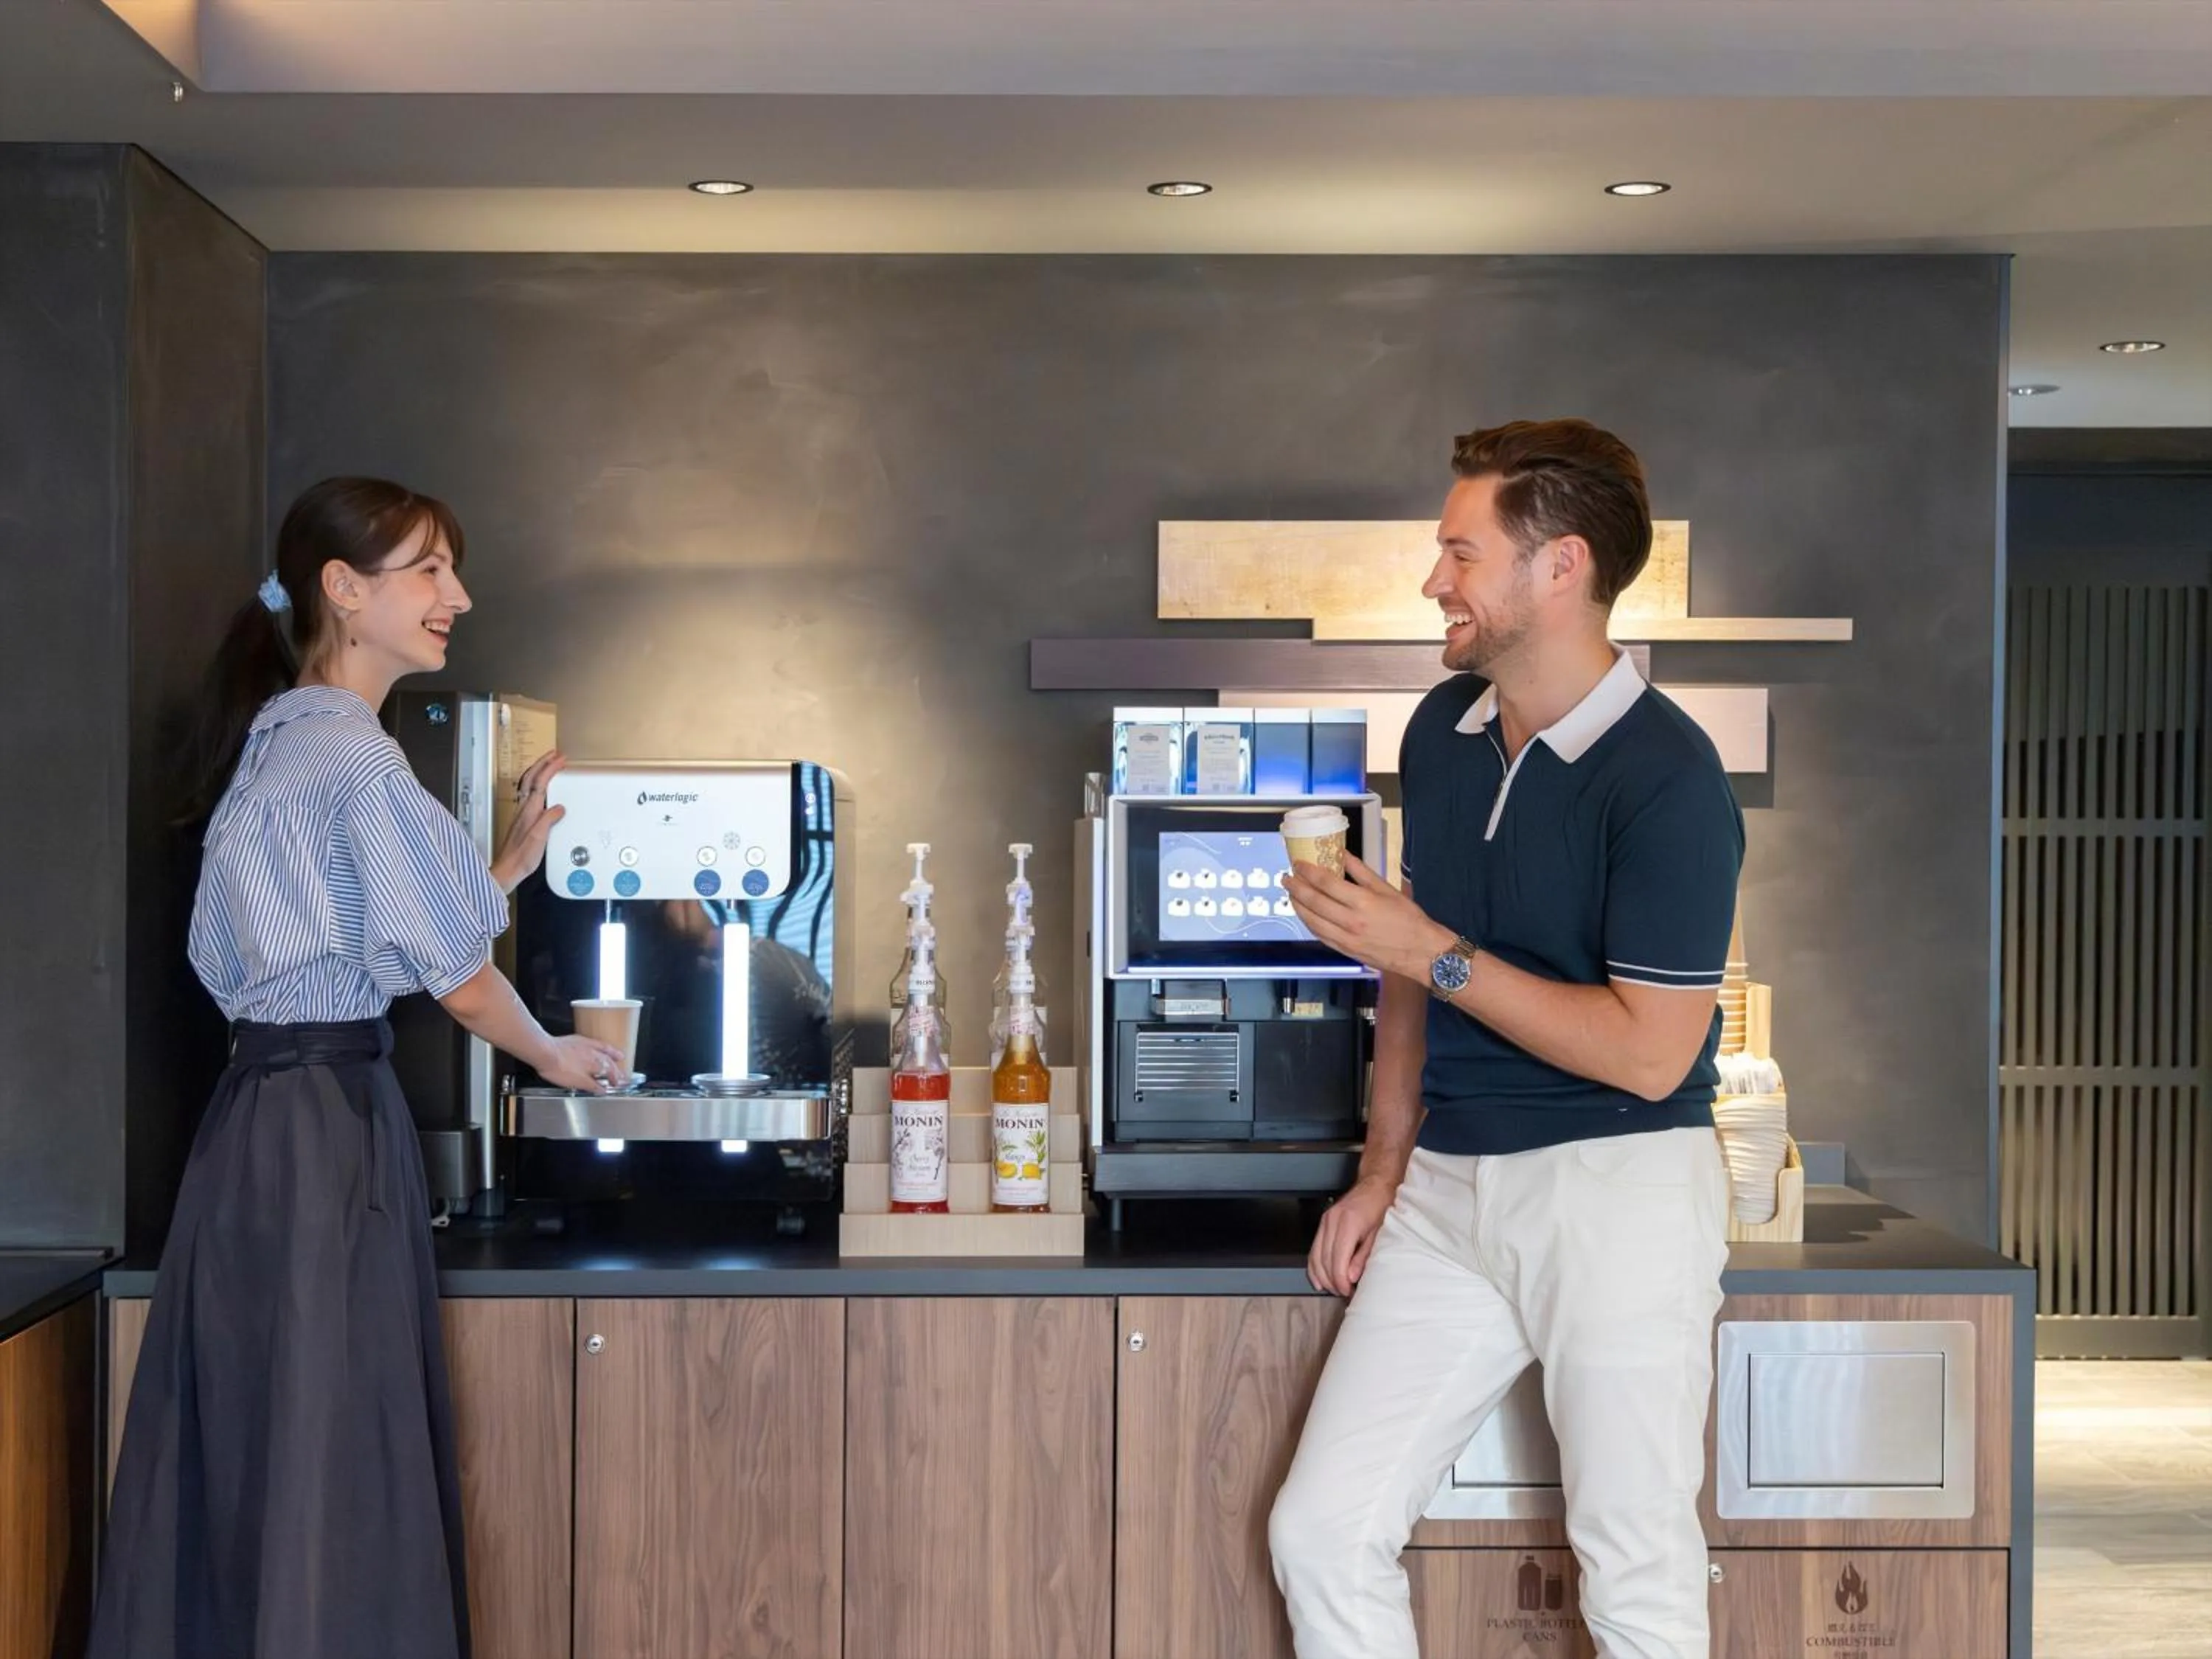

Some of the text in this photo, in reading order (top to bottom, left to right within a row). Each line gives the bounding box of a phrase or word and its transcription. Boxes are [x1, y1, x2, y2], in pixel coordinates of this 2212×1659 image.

[649, 793, 698, 804] waterlogic
[894, 1115, 943, 1127] MONIN
[995, 1118, 1043, 1129] MONIN
[1487, 1618, 1536, 1629] PLASTIC
[1523, 1632, 1557, 1642] CANS
[1806, 1636, 1896, 1647] COMBUSTIBLE
